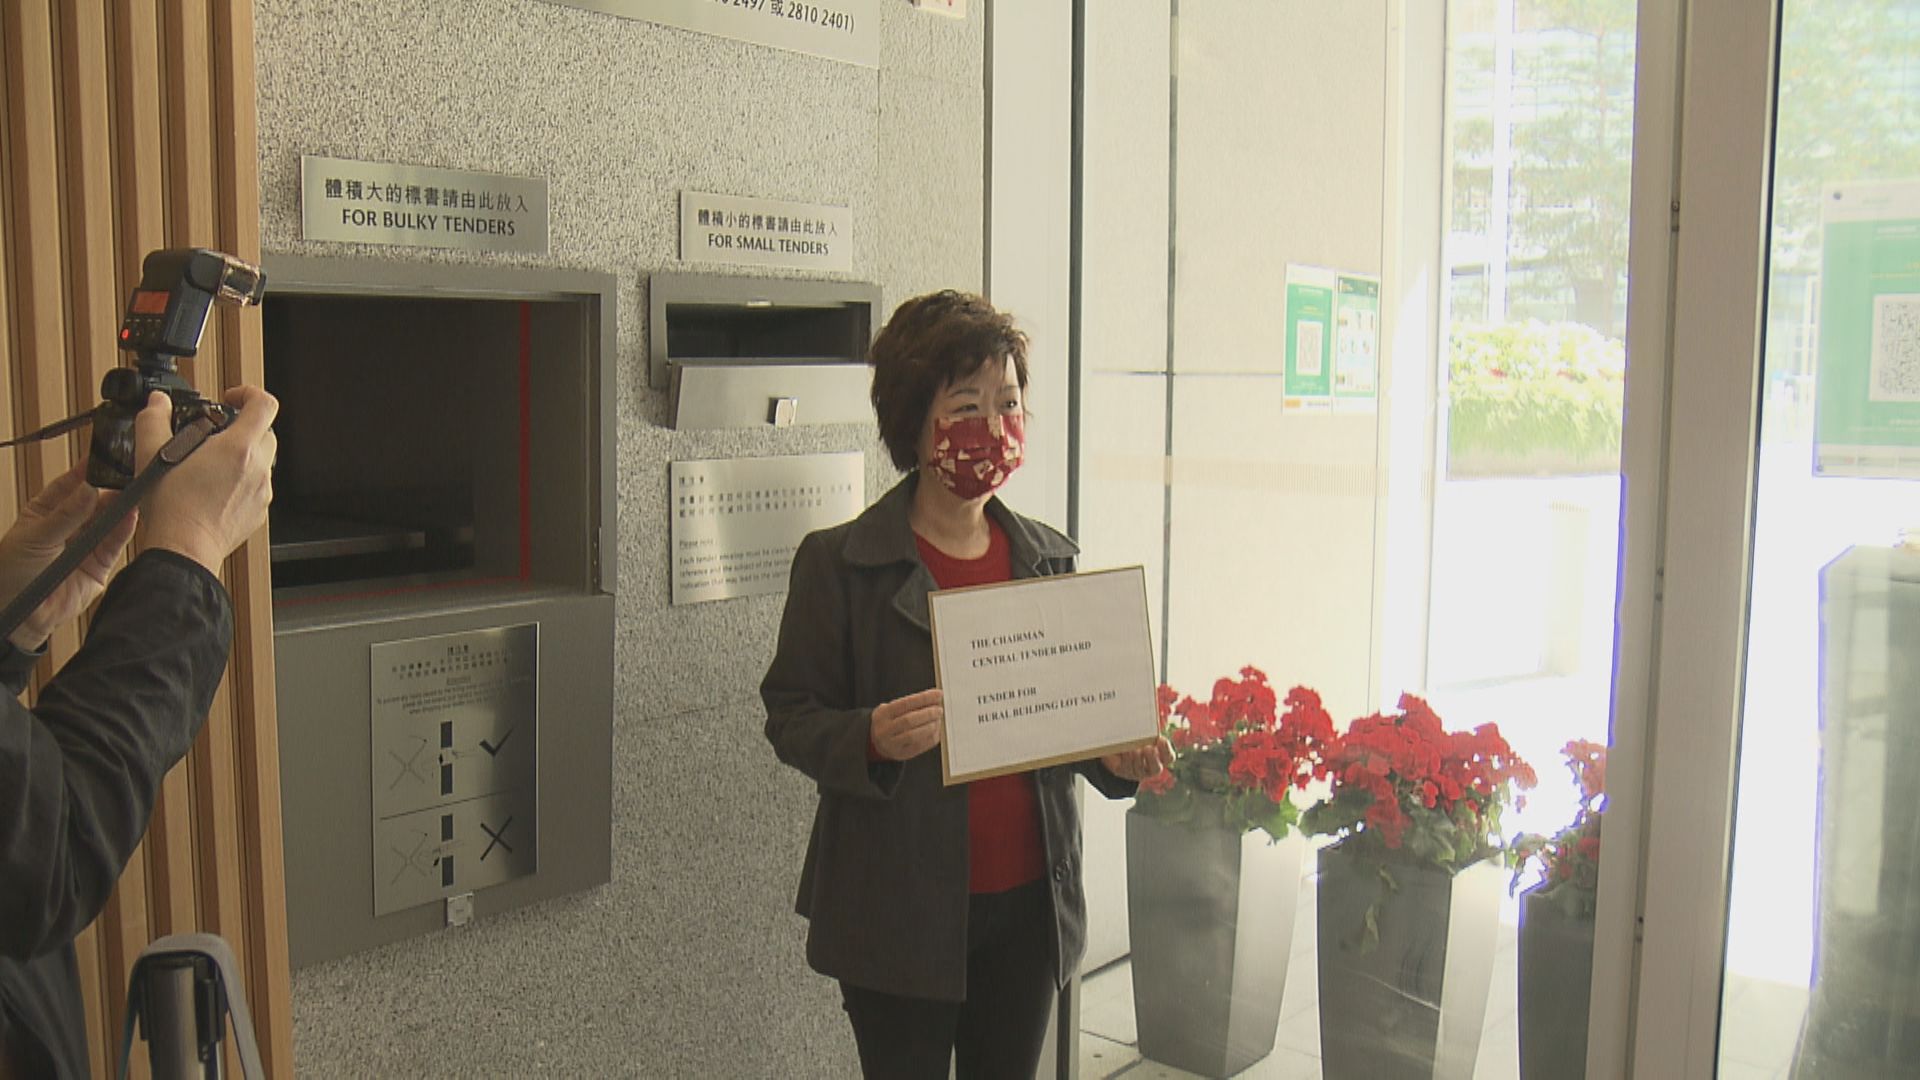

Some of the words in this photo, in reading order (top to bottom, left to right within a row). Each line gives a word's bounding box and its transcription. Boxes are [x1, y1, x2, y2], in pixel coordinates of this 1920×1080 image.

[787, 3, 818, 23] 2810
[821, 9, 855, 34] 2401)
[325, 178, 529, 213] 體積大的標書請由此放入
[342, 208, 377, 226] FOR
[383, 210, 438, 231] BULKY
[442, 215, 515, 236] TENDERS
[698, 208, 838, 237] 體積小的標書請由此放入
[708, 233, 732, 248] FOR
[736, 235, 775, 251] SMALL
[778, 239, 829, 255] TENDERS
[971, 638, 991, 650] THE
[992, 629, 1045, 648] CHAIRMAN
[972, 652, 1017, 668] CENTRAL
[1020, 645, 1057, 661] TENDER
[1058, 640, 1092, 655] BOARD
[977, 690, 1016, 705] TENDER
[1017, 686, 1037, 699] FOR
[977, 708, 1012, 724] RURAL
[1012, 699, 1059, 718] BUILDING
[1060, 696, 1079, 709] LOT
[1080, 693, 1097, 705] NO.
